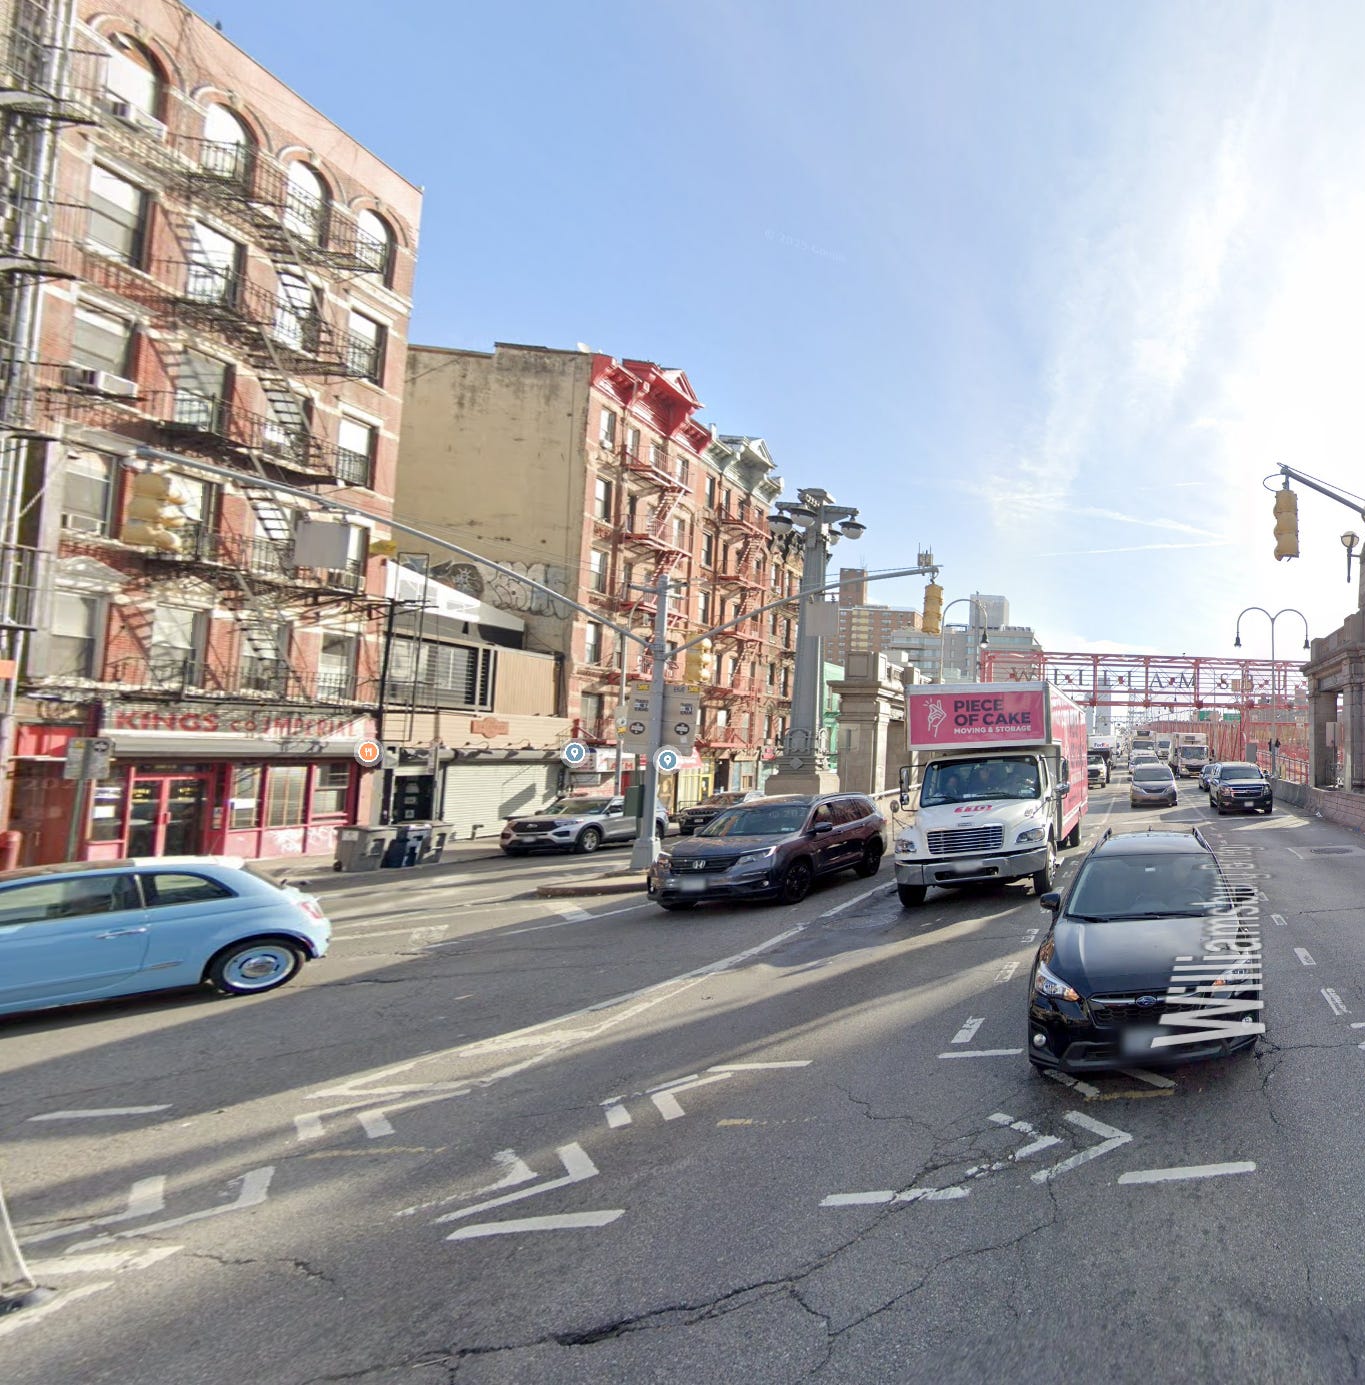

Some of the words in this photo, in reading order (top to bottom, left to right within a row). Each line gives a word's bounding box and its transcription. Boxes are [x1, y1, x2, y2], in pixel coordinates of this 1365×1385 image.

[954, 699, 1004, 712] PIECE
[114, 711, 219, 732] KINGS
[954, 713, 978, 727] OF
[982, 712, 1031, 726] CAKE
[953, 726, 987, 734] MOVING
[995, 725, 1032, 733] STORAGE
